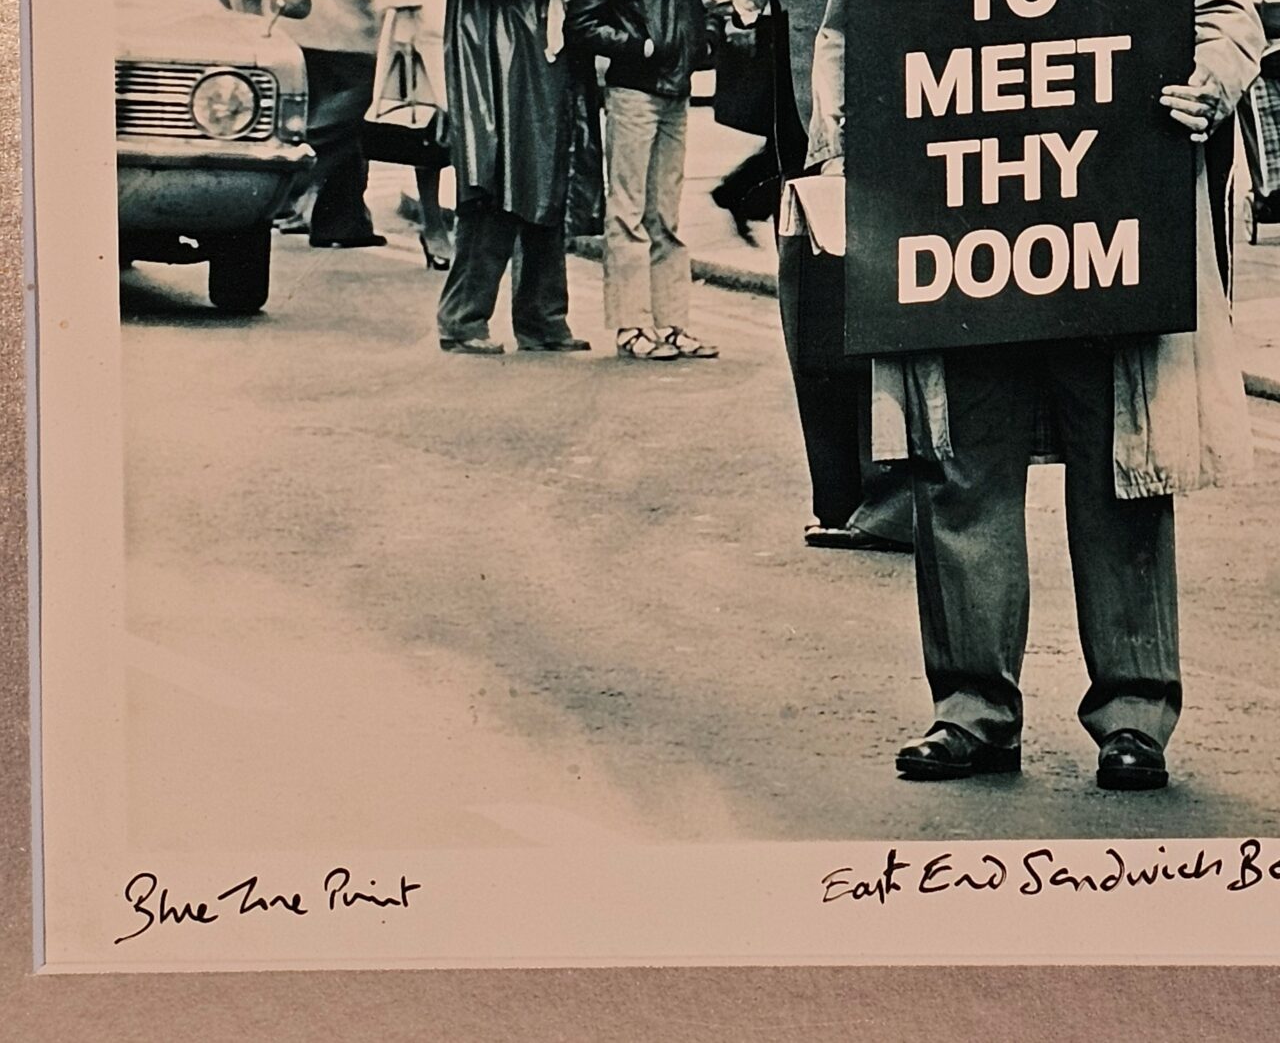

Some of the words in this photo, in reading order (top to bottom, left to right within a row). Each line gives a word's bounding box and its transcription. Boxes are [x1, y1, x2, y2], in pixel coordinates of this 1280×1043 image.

[905, 35, 1132, 119] MEET
[926, 129, 1099, 208] THY
[897, 218, 1140, 304] DOOM
[113, 872, 218, 945] Blue
[324, 867, 421, 911] Print
[821, 849, 910, 905] East
[918, 853, 1007, 894] End
[1019, 845, 1222, 896] Sandwich
